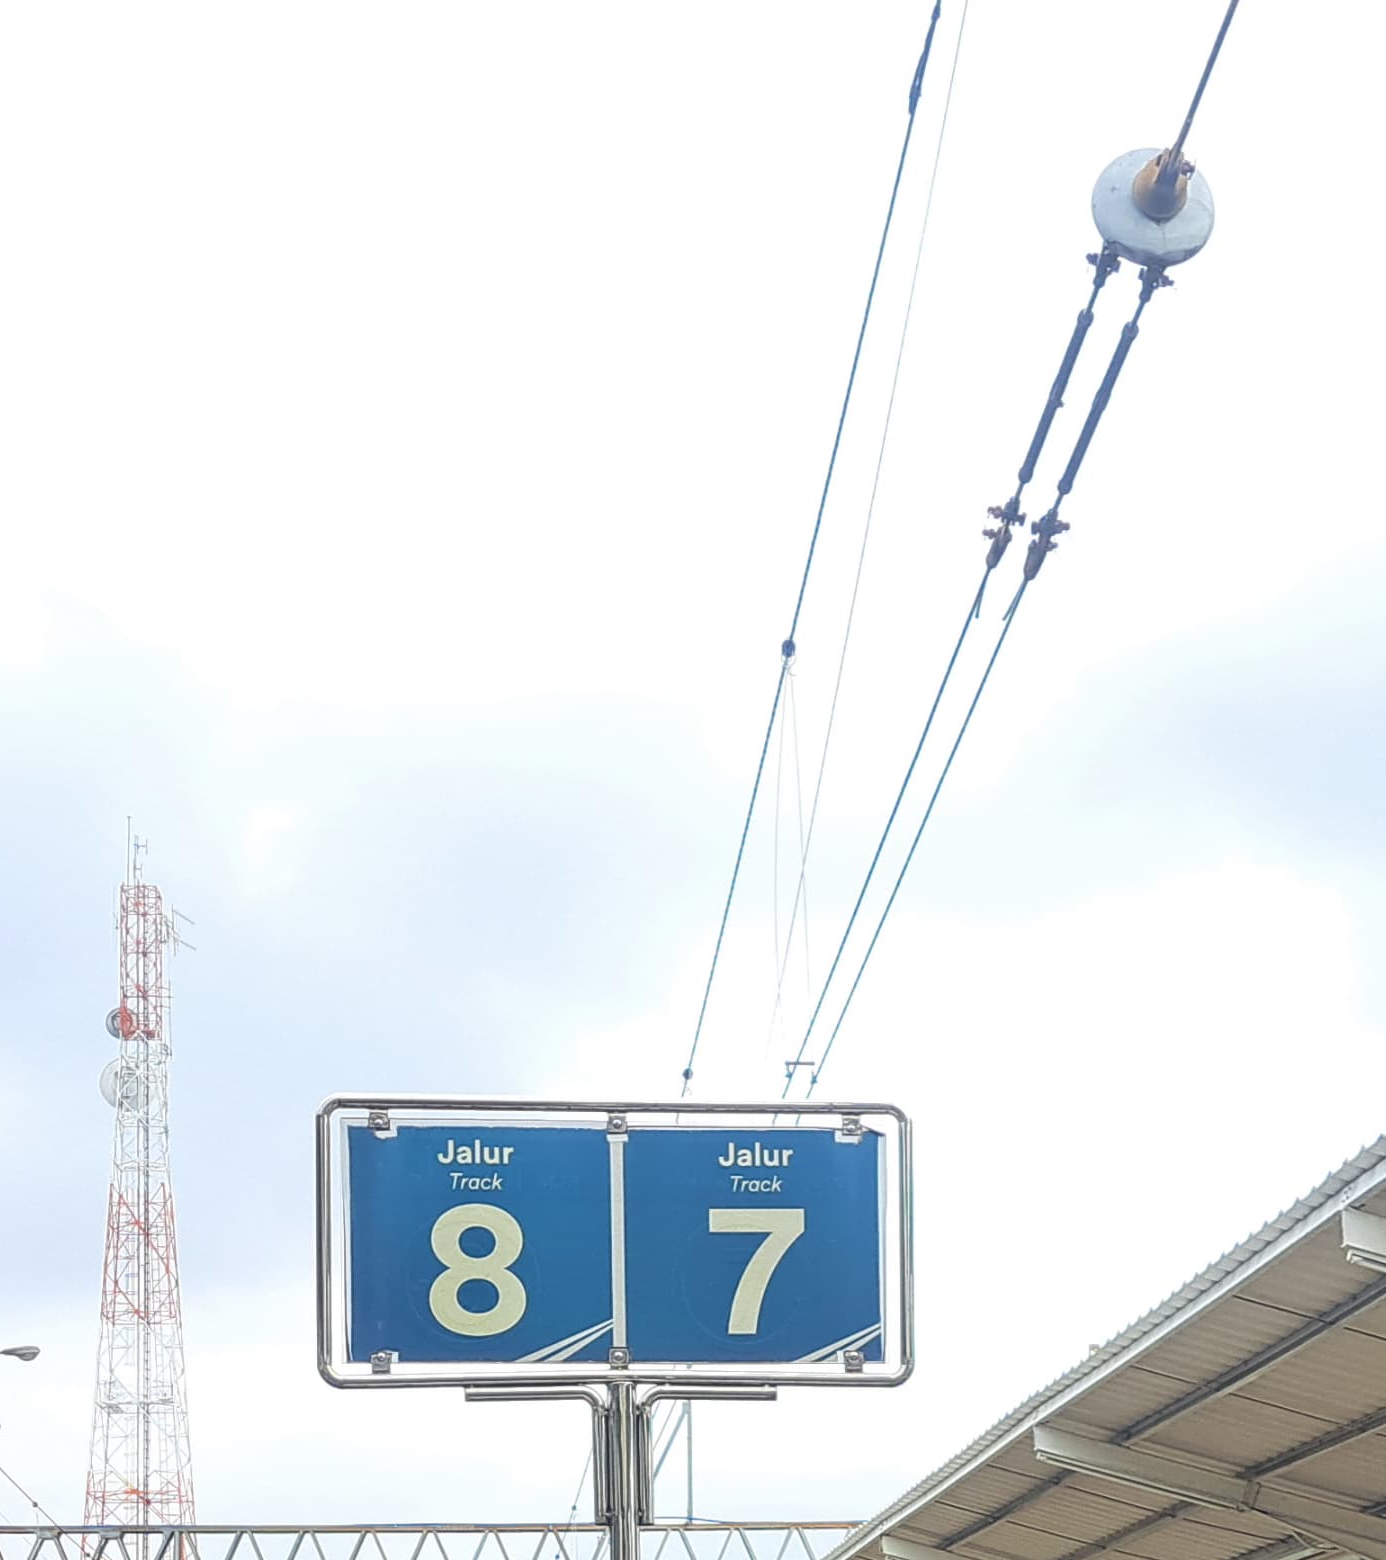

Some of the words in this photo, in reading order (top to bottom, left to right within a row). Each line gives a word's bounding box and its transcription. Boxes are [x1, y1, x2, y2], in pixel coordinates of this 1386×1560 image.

[437, 1139, 515, 1166] Jalur
[718, 1142, 795, 1168] Jalur
[449, 1172, 503, 1191] Track
[730, 1175, 782, 1193] Track
[428, 1203, 527, 1337] 8
[708, 1208, 806, 1335] 7
